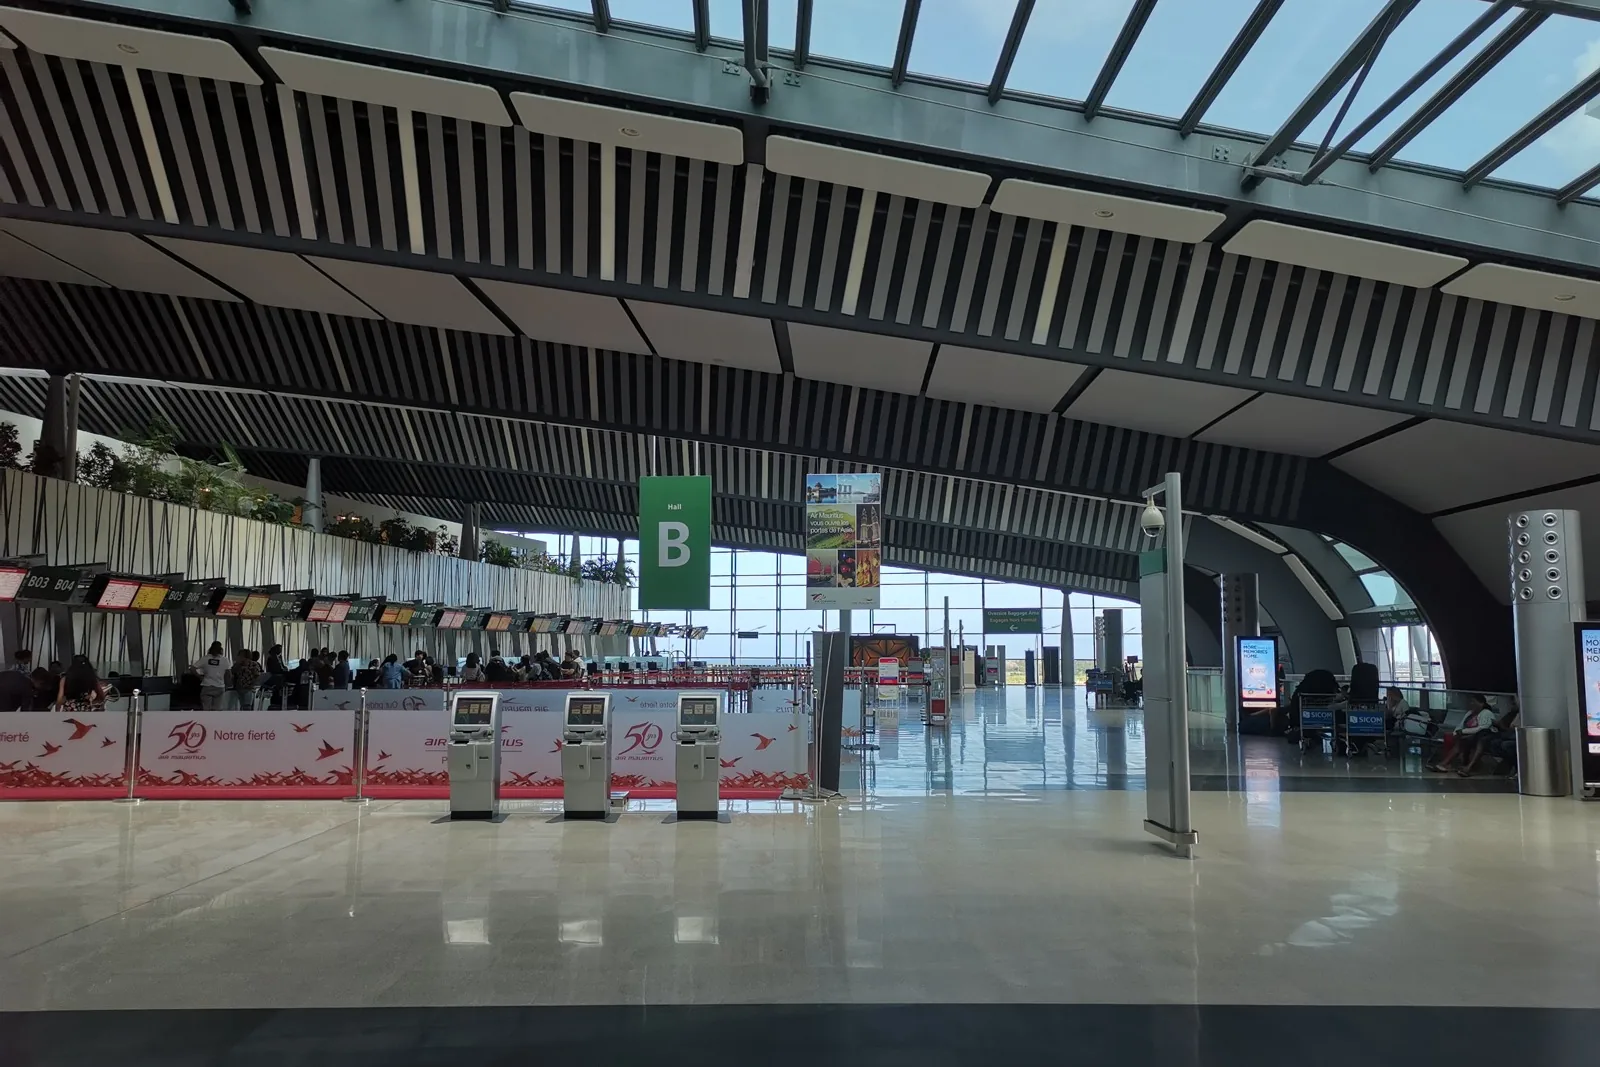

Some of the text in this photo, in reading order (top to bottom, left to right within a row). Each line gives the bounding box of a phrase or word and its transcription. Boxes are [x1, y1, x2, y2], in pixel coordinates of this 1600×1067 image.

[658, 521, 691, 568] B
[28, 575, 50, 588] B03
[54, 579, 76, 591] B04
[168, 591, 184, 601] B05
[161, 720, 207, 755] 50
[213, 729, 276, 741] Notre fierté
[618, 721, 663, 755] 50
